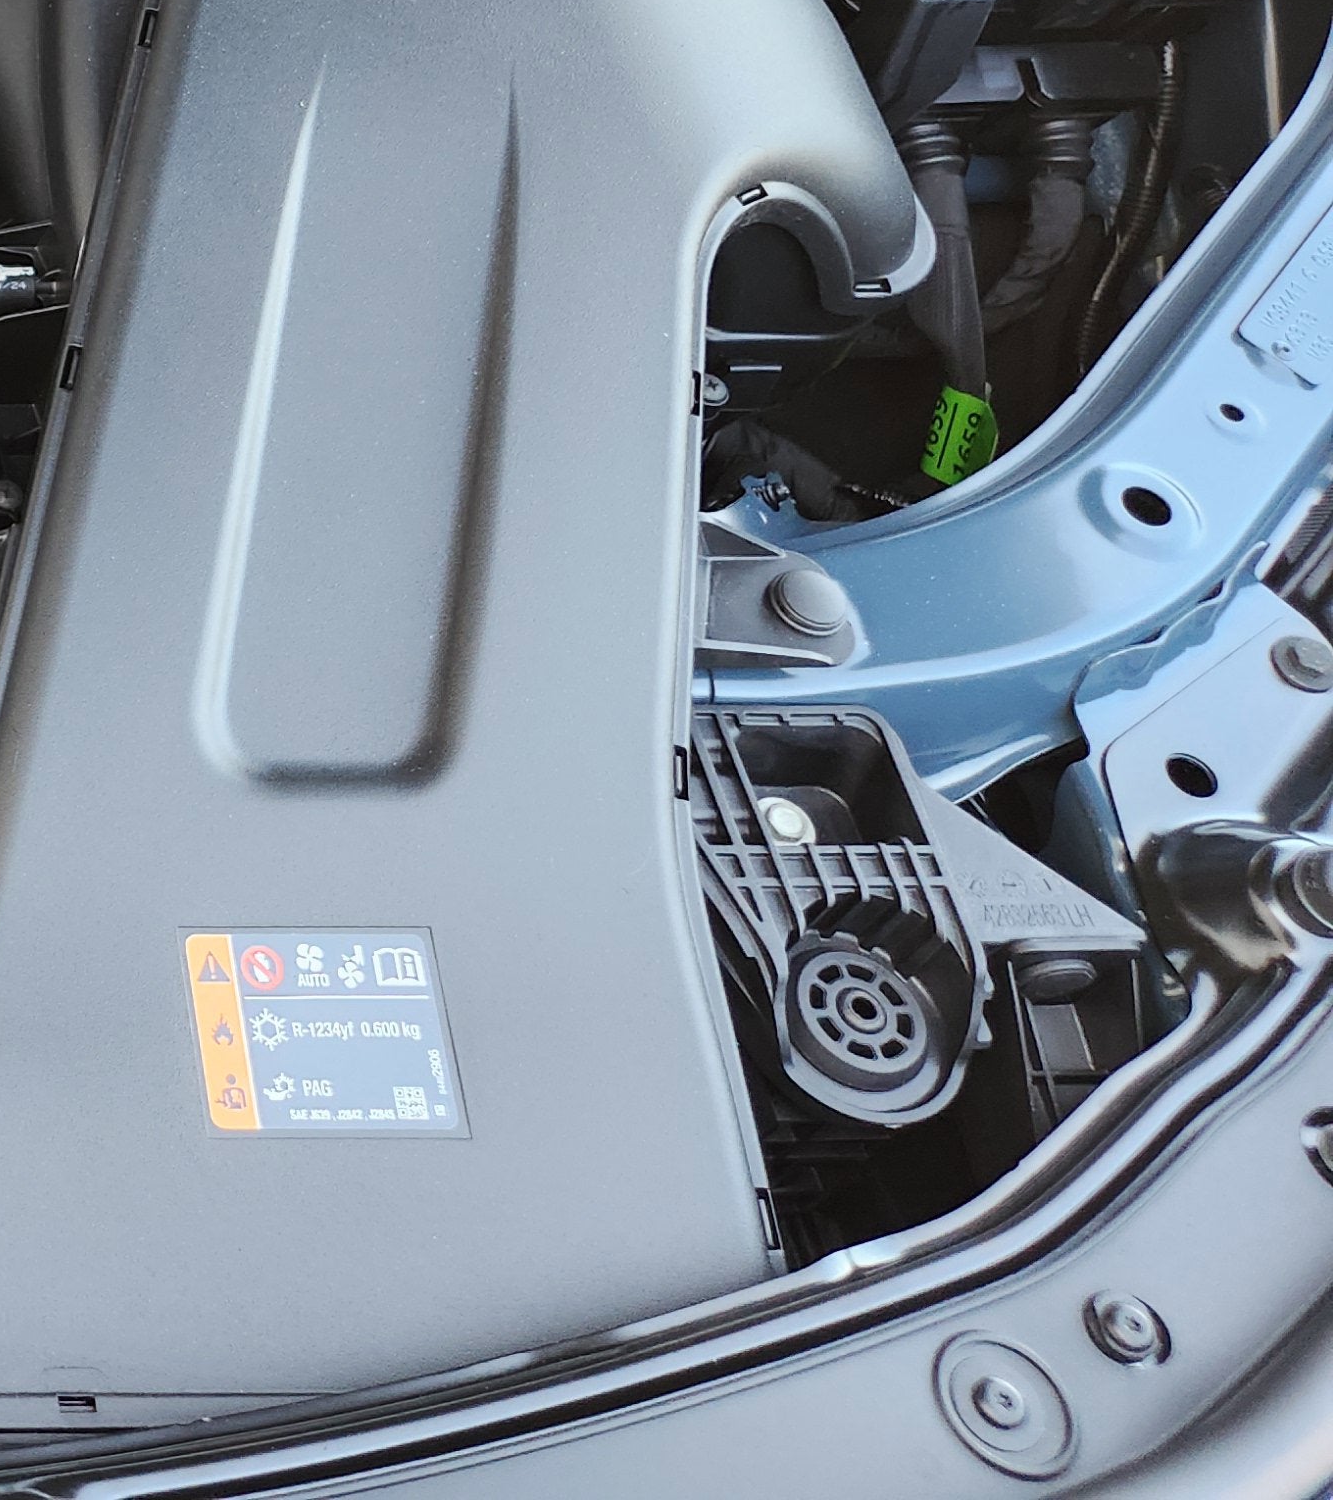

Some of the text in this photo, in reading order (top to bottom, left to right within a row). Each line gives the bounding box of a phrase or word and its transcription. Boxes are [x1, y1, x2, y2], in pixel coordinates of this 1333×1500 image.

[297, 973, 330, 988] AUTO
[291, 1021, 422, 1041] R-1234yf 0.600 kg
[301, 1079, 334, 1098] PAG
[289, 1108, 308, 1121] SAE
